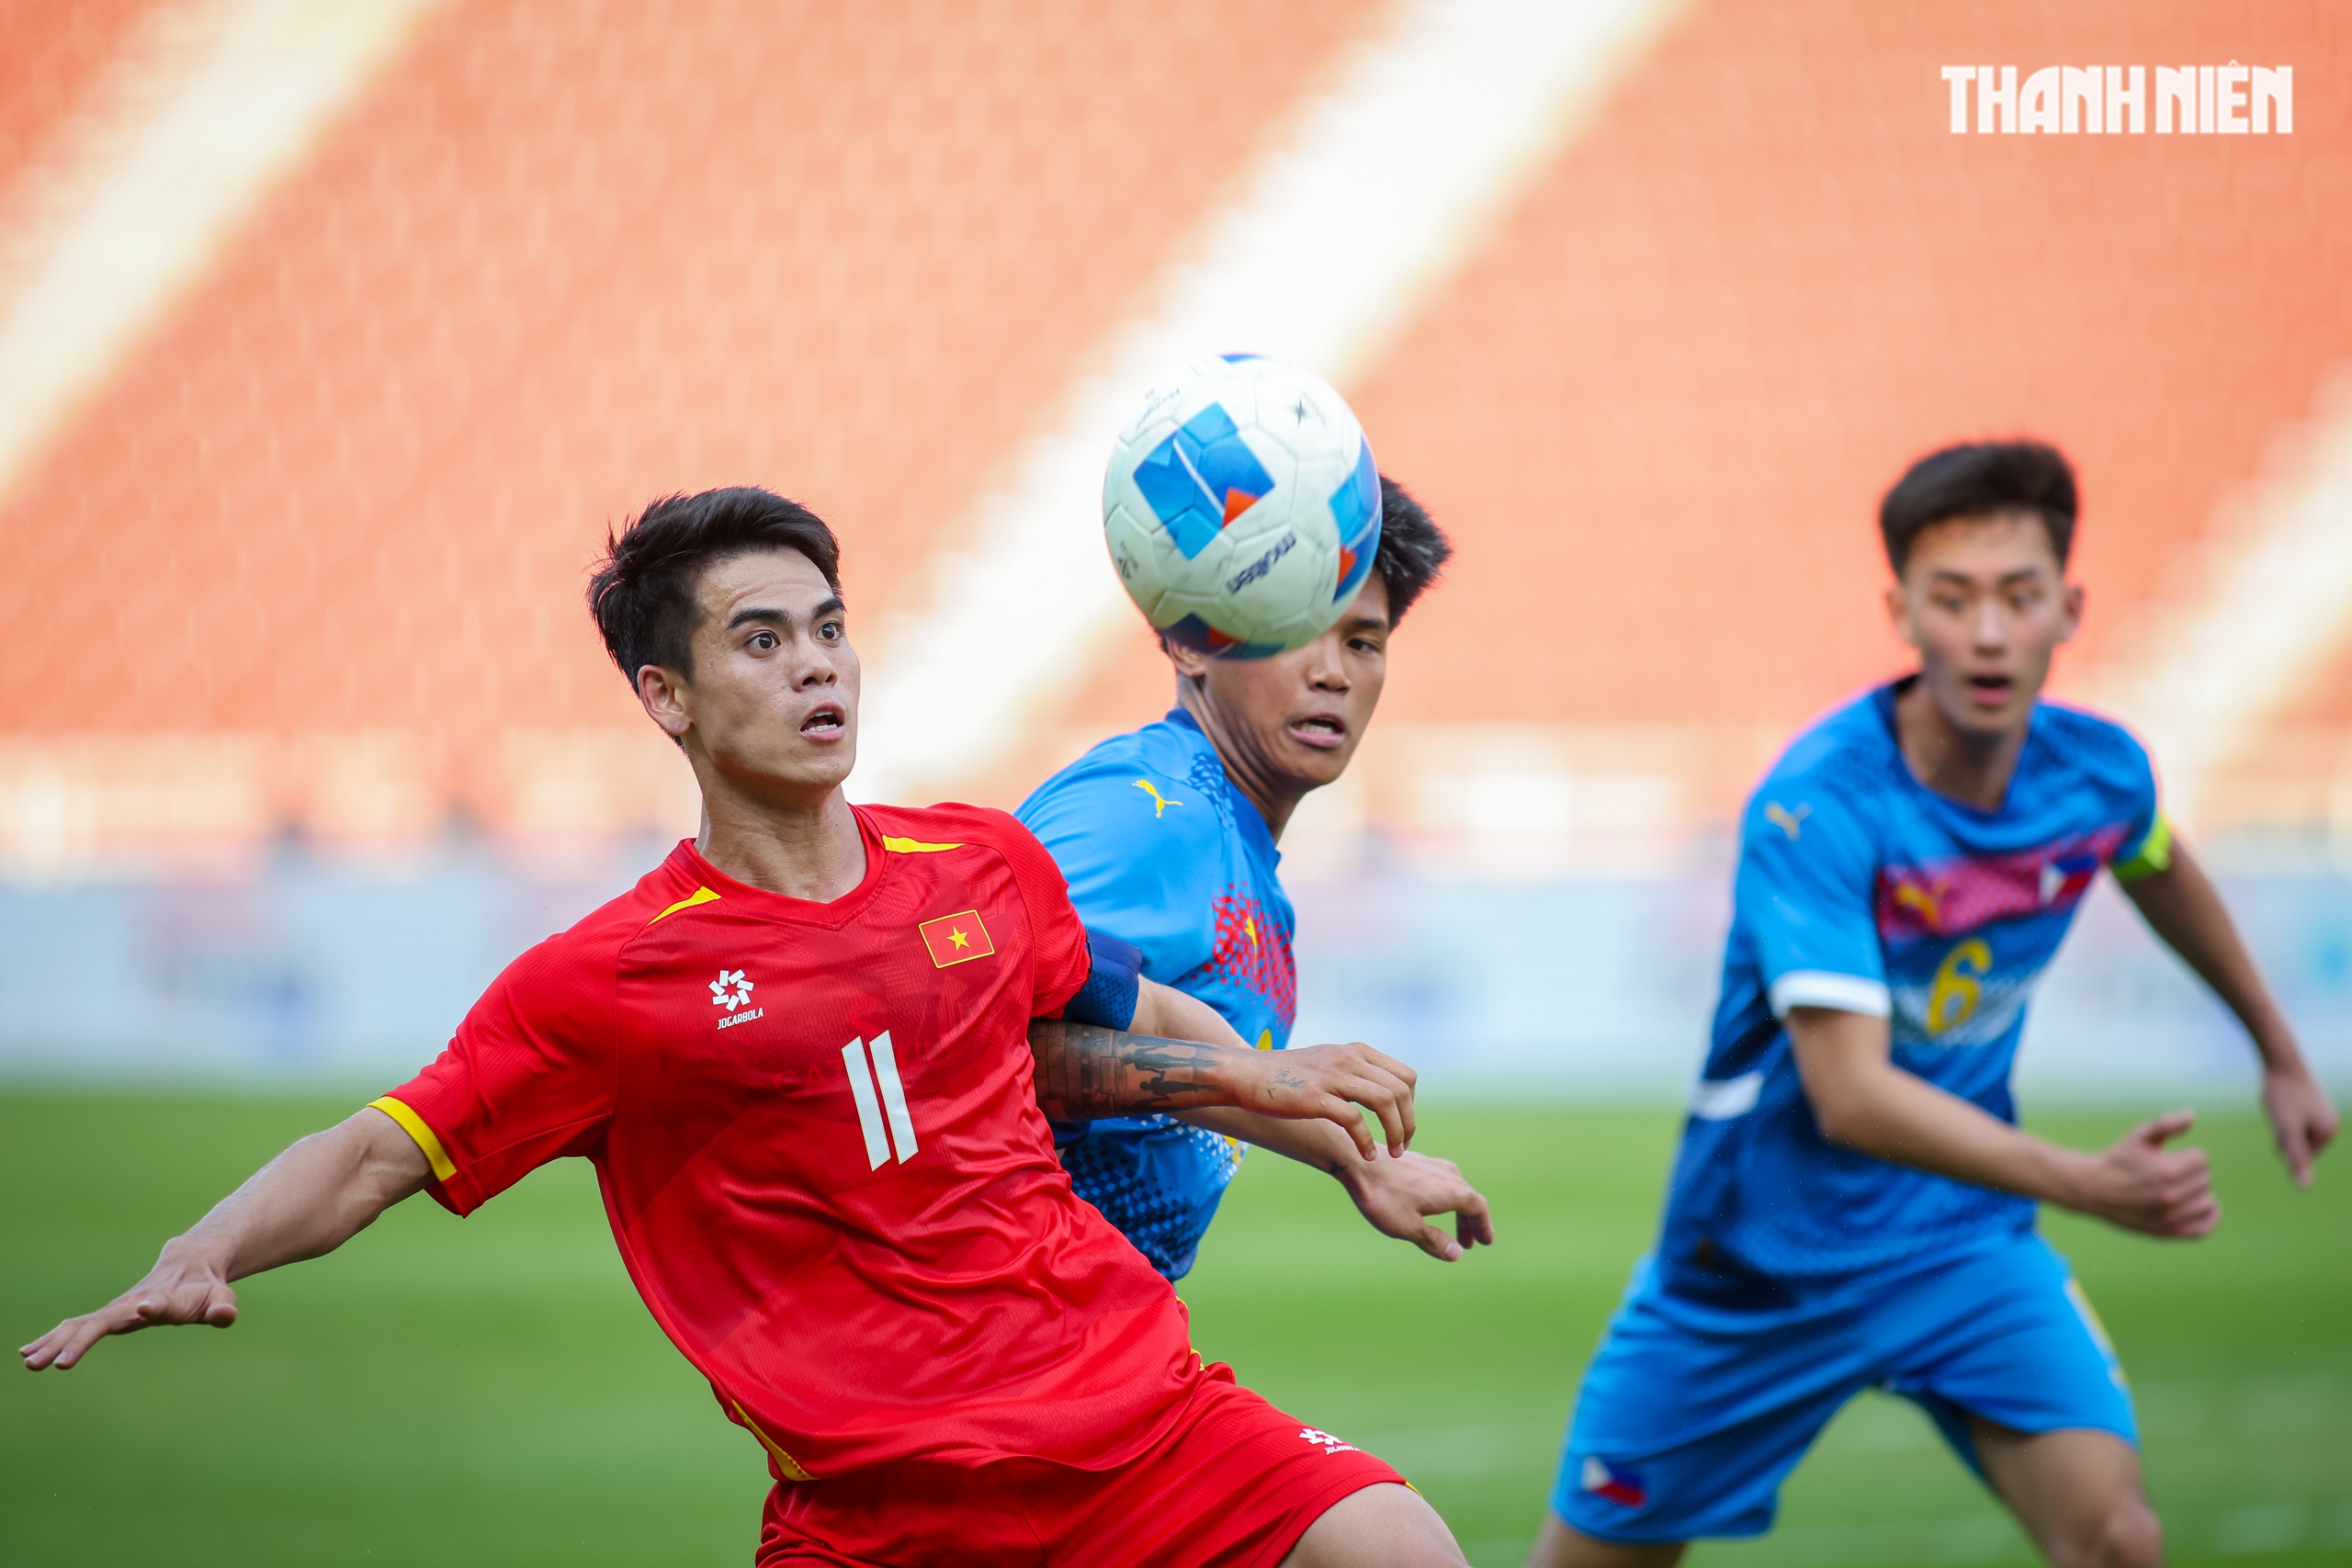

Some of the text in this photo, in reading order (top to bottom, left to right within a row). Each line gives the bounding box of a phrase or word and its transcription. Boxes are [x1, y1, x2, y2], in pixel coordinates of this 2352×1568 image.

[717, 1007, 763, 1030] JOGARBOLA
[1925, 937, 1992, 1037] 6
[841, 1029, 919, 1172] 11
